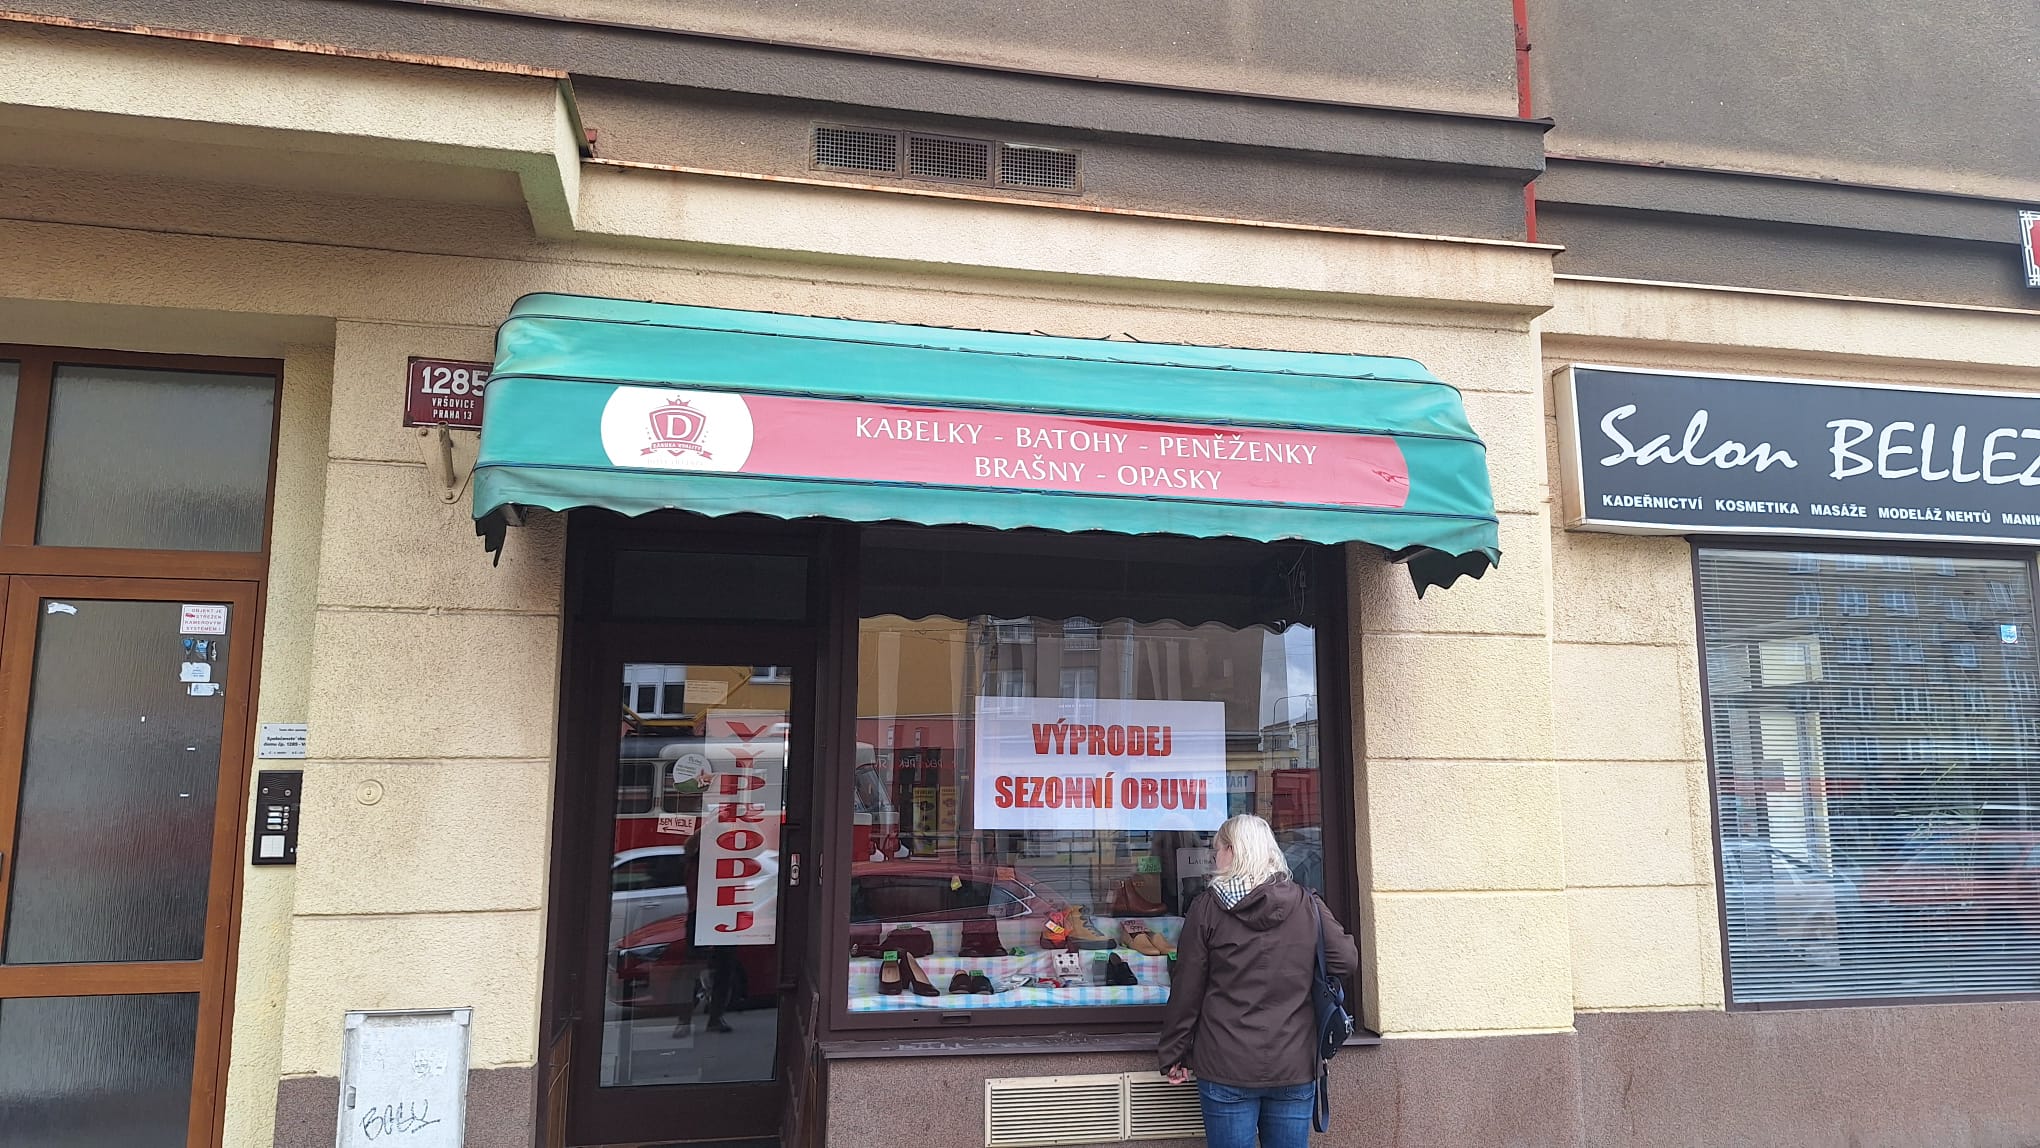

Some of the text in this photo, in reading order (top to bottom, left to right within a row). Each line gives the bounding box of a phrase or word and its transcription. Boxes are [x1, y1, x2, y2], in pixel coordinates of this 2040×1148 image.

[421, 366, 489, 397] 1285
[431, 396, 475, 409] VRŠOVICE
[433, 409, 473, 420] PRAHA 13
[665, 414, 693, 439] D
[855, 416, 983, 444] KABELKY
[1016, 427, 1128, 453] BATOHY
[1159, 432, 1318, 465] PENĚŽENKY
[1600, 404, 1798, 472] Salon
[975, 453, 1086, 482] BRAŠNY
[1117, 465, 1222, 490] OPASKY
[1602, 494, 1703, 510] KADEŘNICTVÍ
[1715, 499, 1800, 514] KOSMETIKA
[1810, 503, 1867, 518] MASÁŽE
[1878, 506, 1942, 521] MODELÁŽ
[1946, 509, 1991, 524] NEHTŮ
[1031, 717, 1172, 757] VÝPRODEJ
[994, 771, 1208, 810] SEZONNÍ OBUVI
